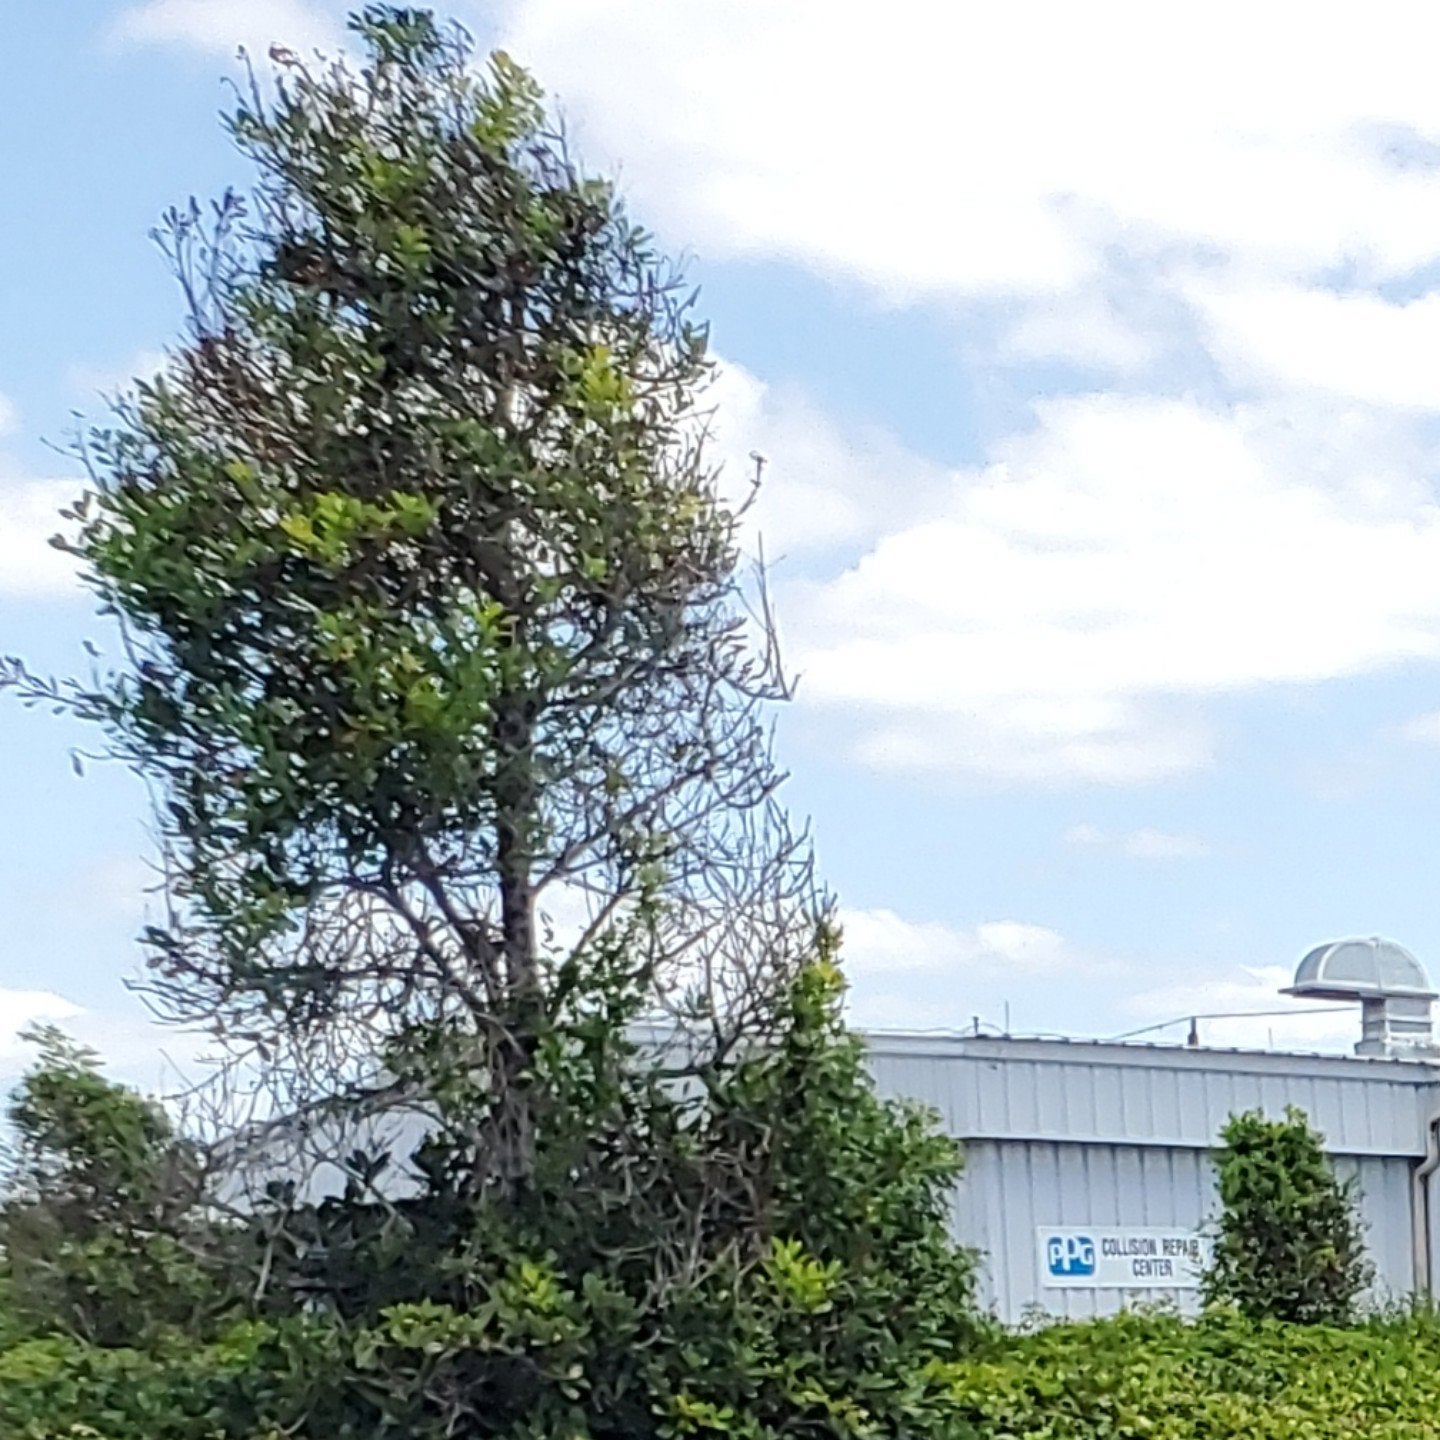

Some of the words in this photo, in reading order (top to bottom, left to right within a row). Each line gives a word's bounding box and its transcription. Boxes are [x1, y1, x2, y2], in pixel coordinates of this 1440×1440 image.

[1050, 1235, 1095, 1271] PPG
[1102, 1237, 1158, 1256] COLLISION
[1161, 1237, 1199, 1256] REPAIR
[1131, 1258, 1174, 1277] CENTER
